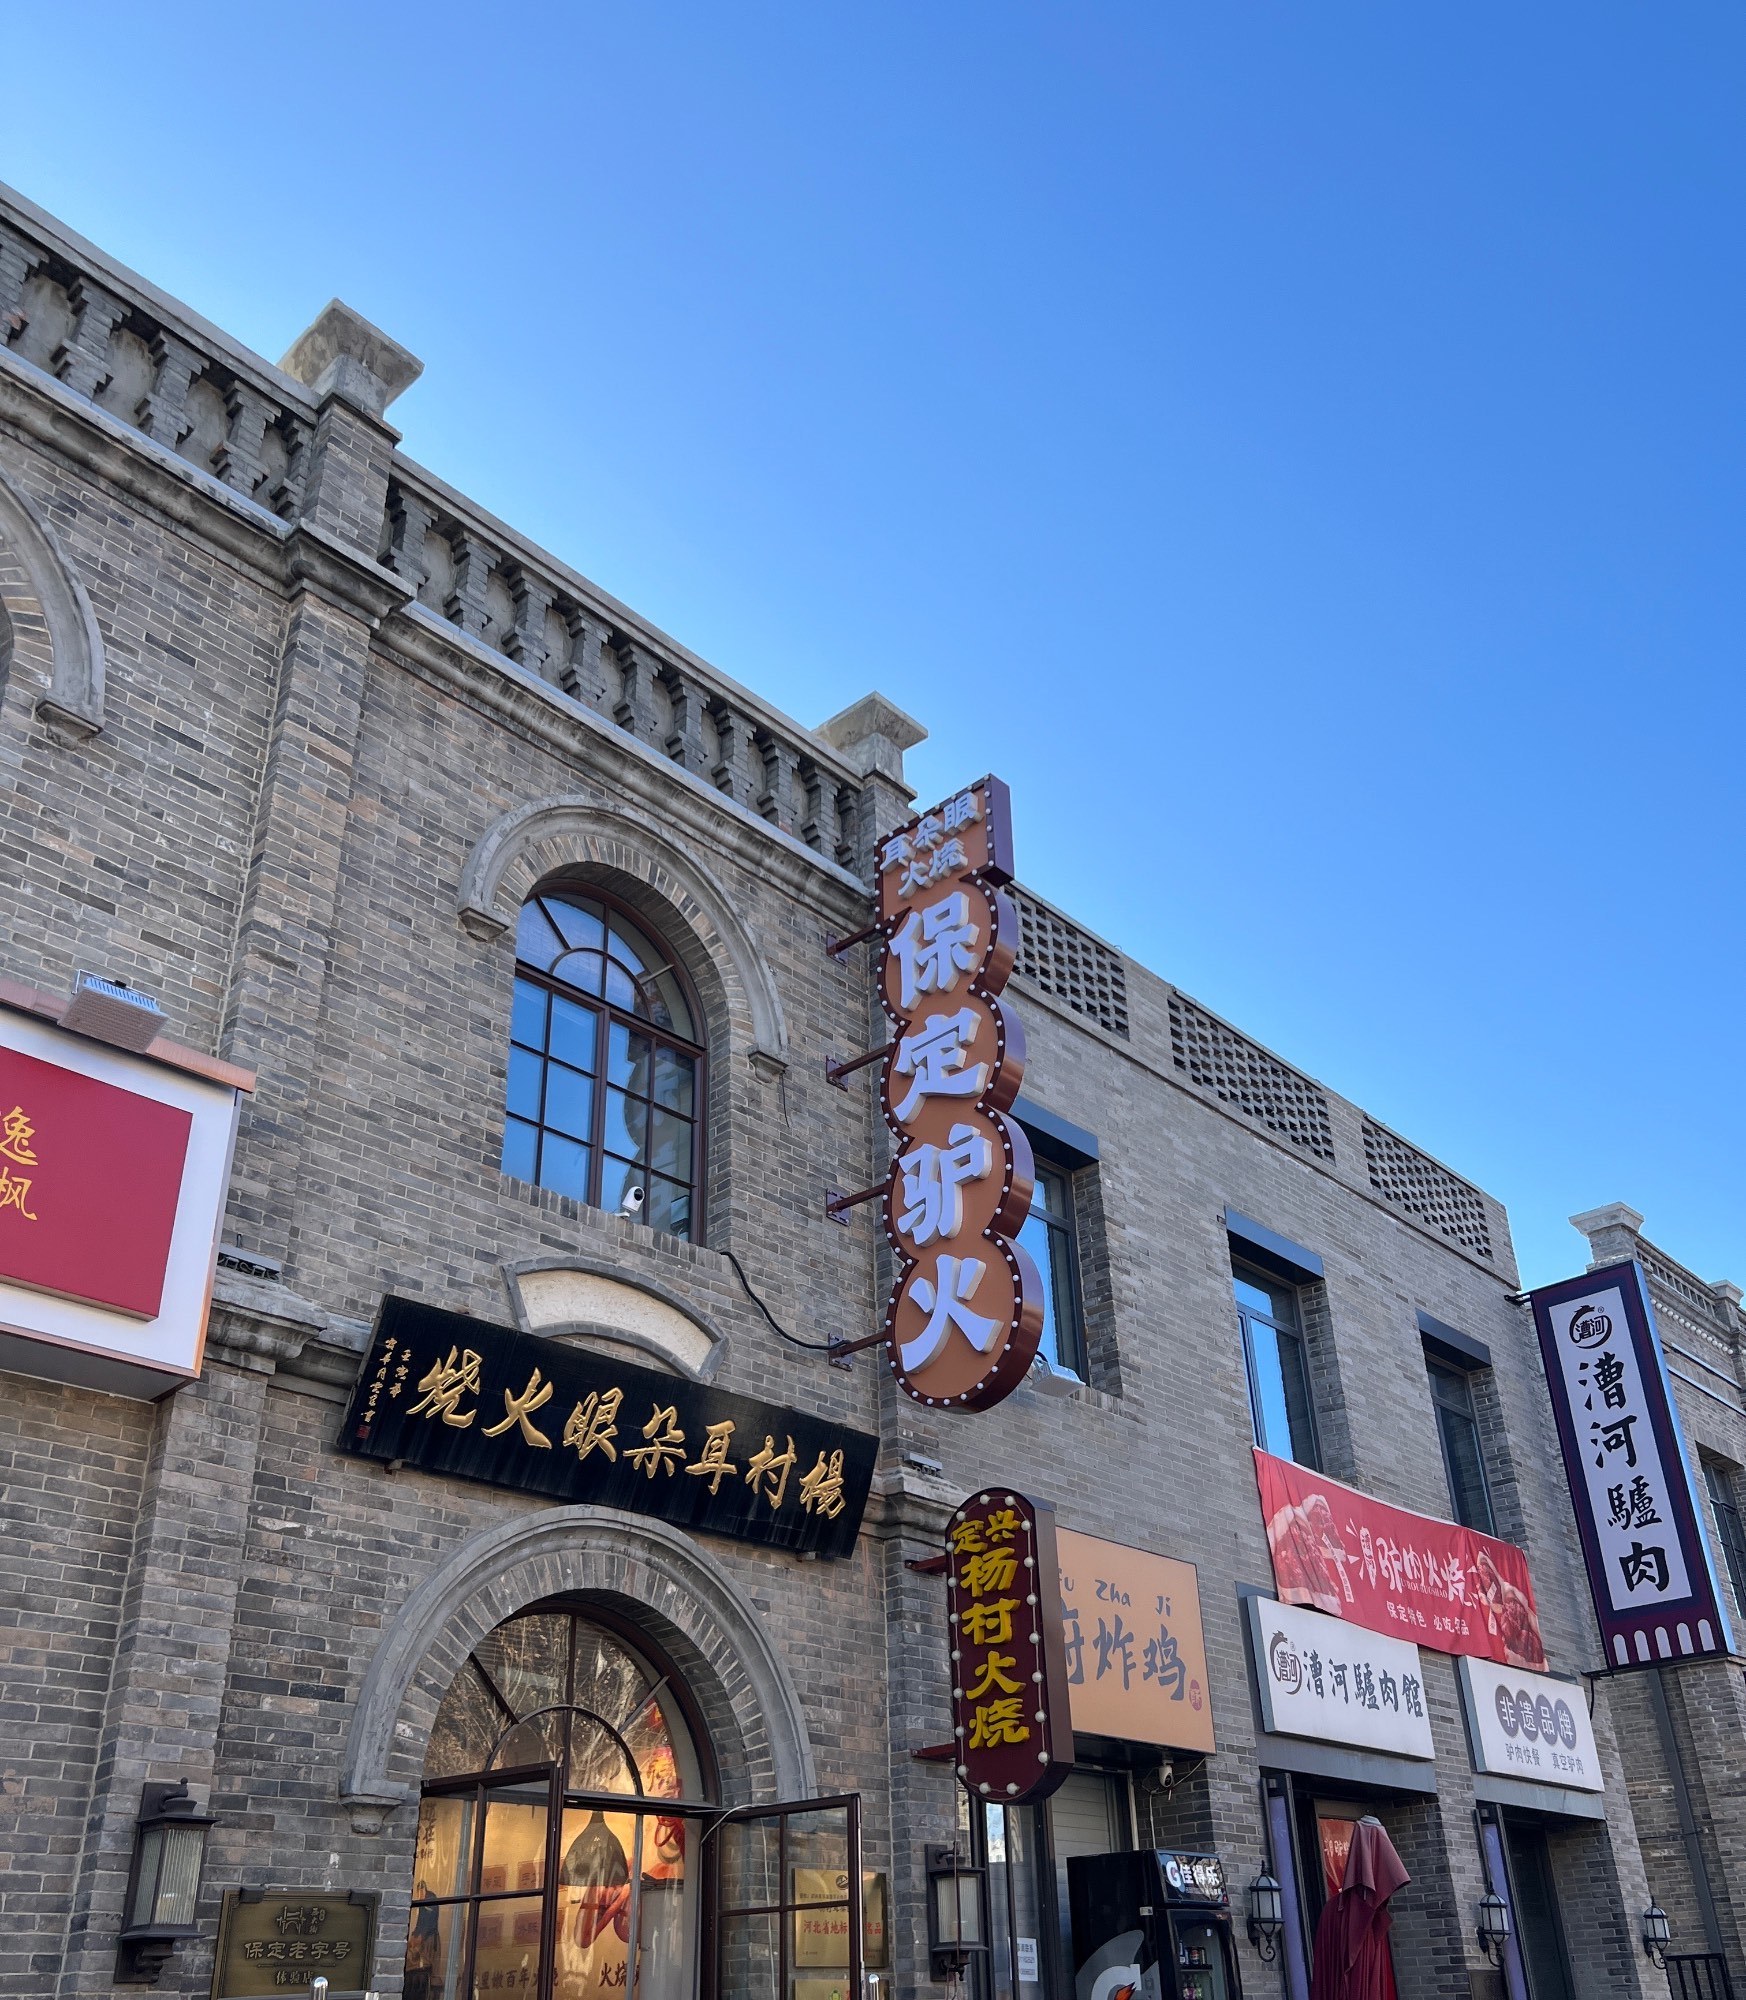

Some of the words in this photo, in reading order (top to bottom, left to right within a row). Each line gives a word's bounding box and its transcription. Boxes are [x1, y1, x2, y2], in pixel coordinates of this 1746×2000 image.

[880, 791, 981, 871] 耳朵眼
[898, 838, 968, 900] 火烧
[888, 890, 1004, 1375] 保定驴火
[1578, 1351, 1670, 1593] 漕河驢肉
[1095, 1579, 1131, 1607] Zha
[1155, 1595, 1171, 1617] Ji
[1386, 1601, 1427, 1628] 保定特色
[1433, 1614, 1470, 1636] 必吃名品
[960, 1547, 1030, 1749] 杨村火烧
[1499, 1695, 1575, 1741] 非遗品牌
[1505, 1743, 1541, 1767] 驴肉快餐
[1551, 1752, 1585, 1775] 真空驴肉
[1180, 1863, 1220, 1887] 佳得乐
[803, 1919, 882, 1935] 河北省地标名品
[244, 1941, 351, 1960] 保定老字号
